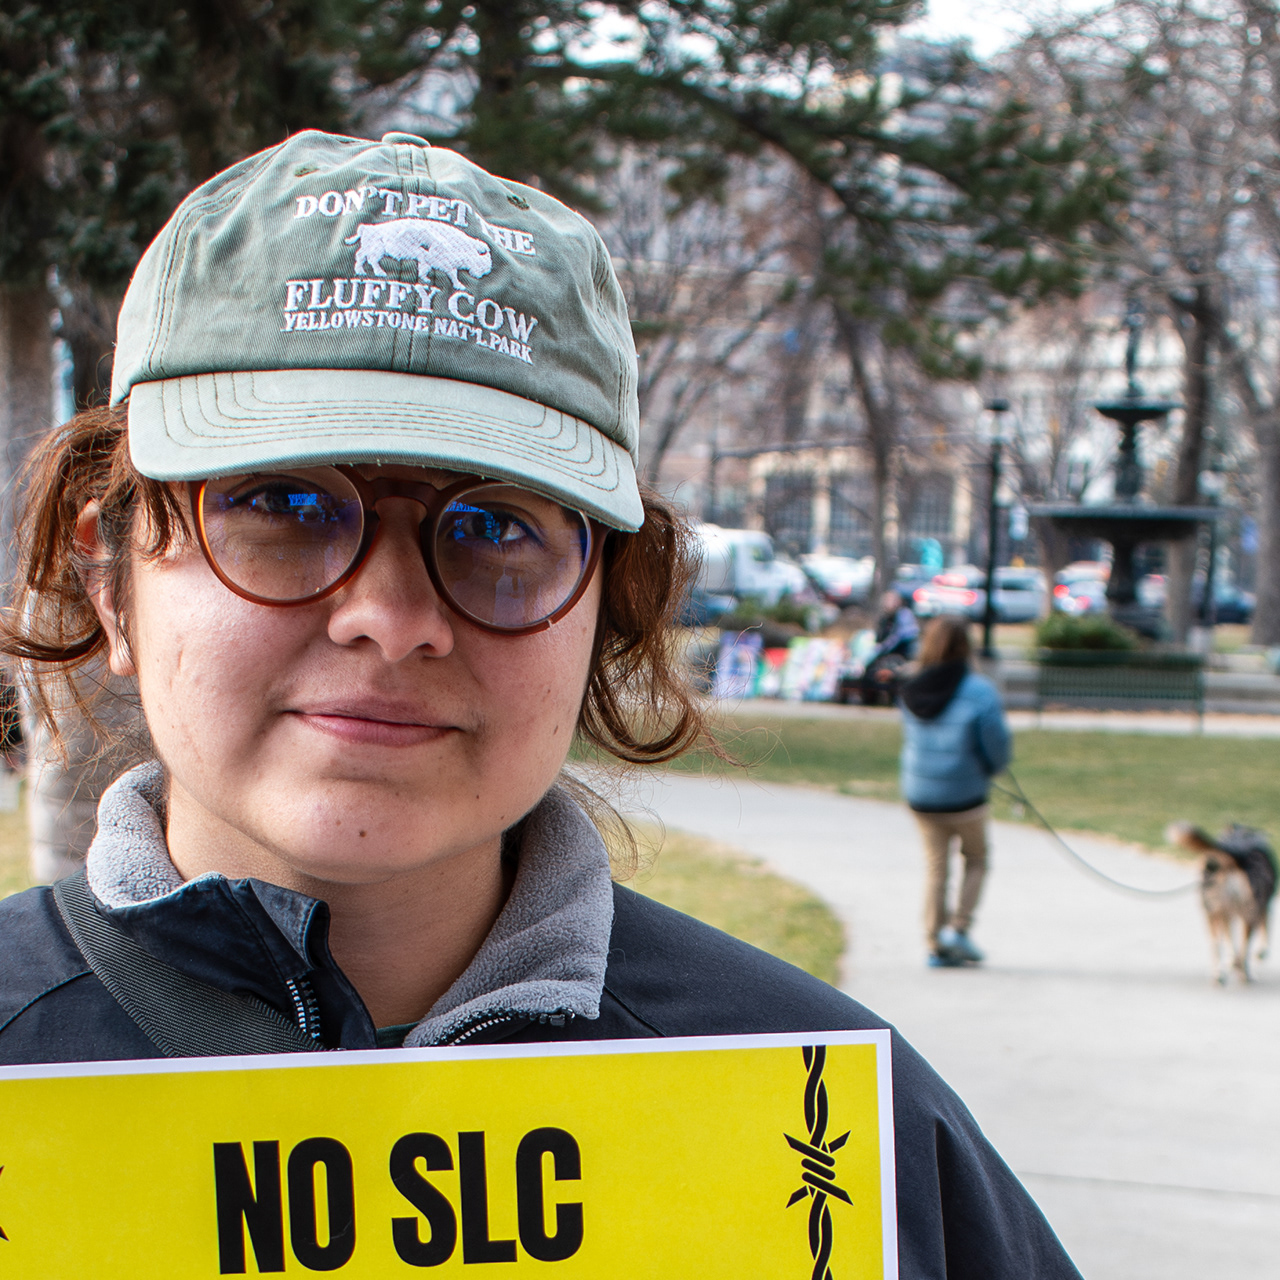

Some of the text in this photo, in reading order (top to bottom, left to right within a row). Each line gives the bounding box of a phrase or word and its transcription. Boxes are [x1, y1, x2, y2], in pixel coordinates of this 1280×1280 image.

[293, 185, 404, 220] DON'T
[405, 194, 473, 227] PET
[280, 309, 429, 333] YELLOWSTONE
[488, 333, 534, 365] PARK
[284, 278, 538, 344] FLUFFY COW
[213, 1127, 585, 1276] NO SLC
